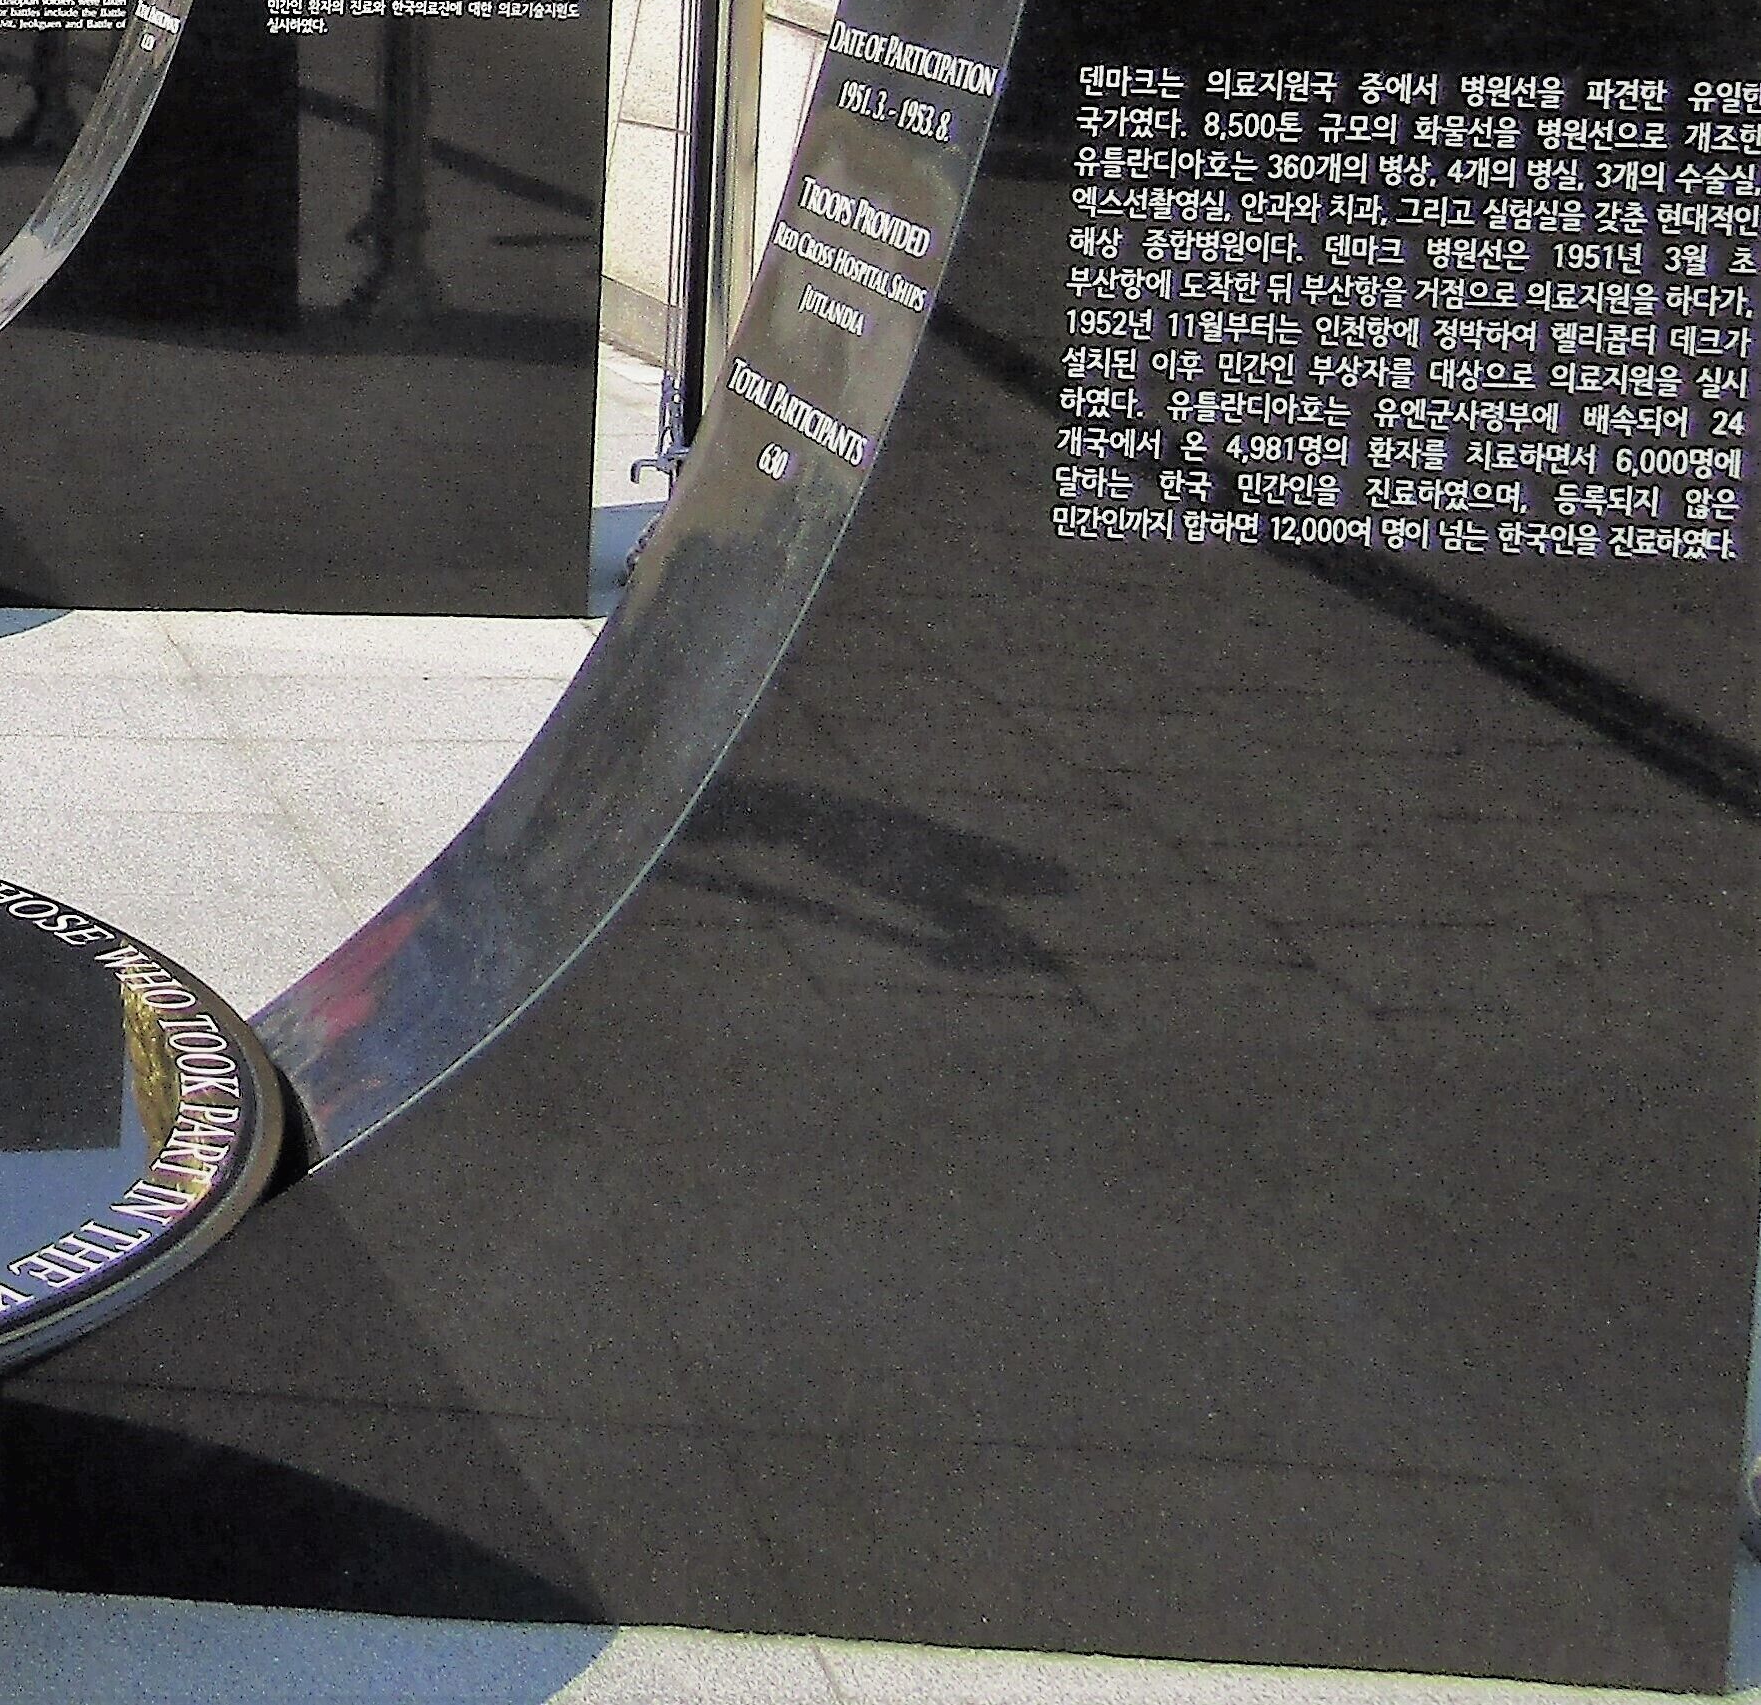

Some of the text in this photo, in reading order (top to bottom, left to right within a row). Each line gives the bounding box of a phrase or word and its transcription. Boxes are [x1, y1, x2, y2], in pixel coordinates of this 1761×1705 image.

[830, 19, 999, 96] DATE OF PARTICIPATION
[1079, 64, 1185, 99] 덴마크는
[1205, 68, 1338, 103] 의료지원국
[1358, 72, 1438, 105] 중에서
[1460, 74, 1565, 110] 병원선을
[1586, 78, 1669, 112] 파견한
[839, 80, 871, 115] 1951.
[873, 90, 888, 120] 3.
[897, 99, 935, 137] 1953.
[936, 111, 951, 142] 8.
[1076, 106, 1187, 139] 국가였다.
[1203, 111, 1303, 143] 8,500톤
[1318, 113, 1397, 145] 규모의
[1413, 114, 1522, 149] 화물선을
[1536, 117, 1668, 151] 병원선으로
[1073, 146, 1761, 197] 유틀란디아호는 360개의 병상, 4개의 병실, 3개의 수술실,
[800, 176, 931, 257] TROOPS PROVIDED
[774, 222, 927, 311] RED CROSS HOSPITAL SHIPS
[798, 284, 865, 336] JUTLANDIA
[728, 358, 868, 466] TOTAL PARTICIPANTS
[758, 443, 788, 479] 630
[94, 945, 197, 1010] WHO
[158, 1014, 240, 1101] TOOK
[150, 1100, 239, 1186] PART
[110, 1179, 199, 1226] IN
[8, 1220, 152, 1289] THE
